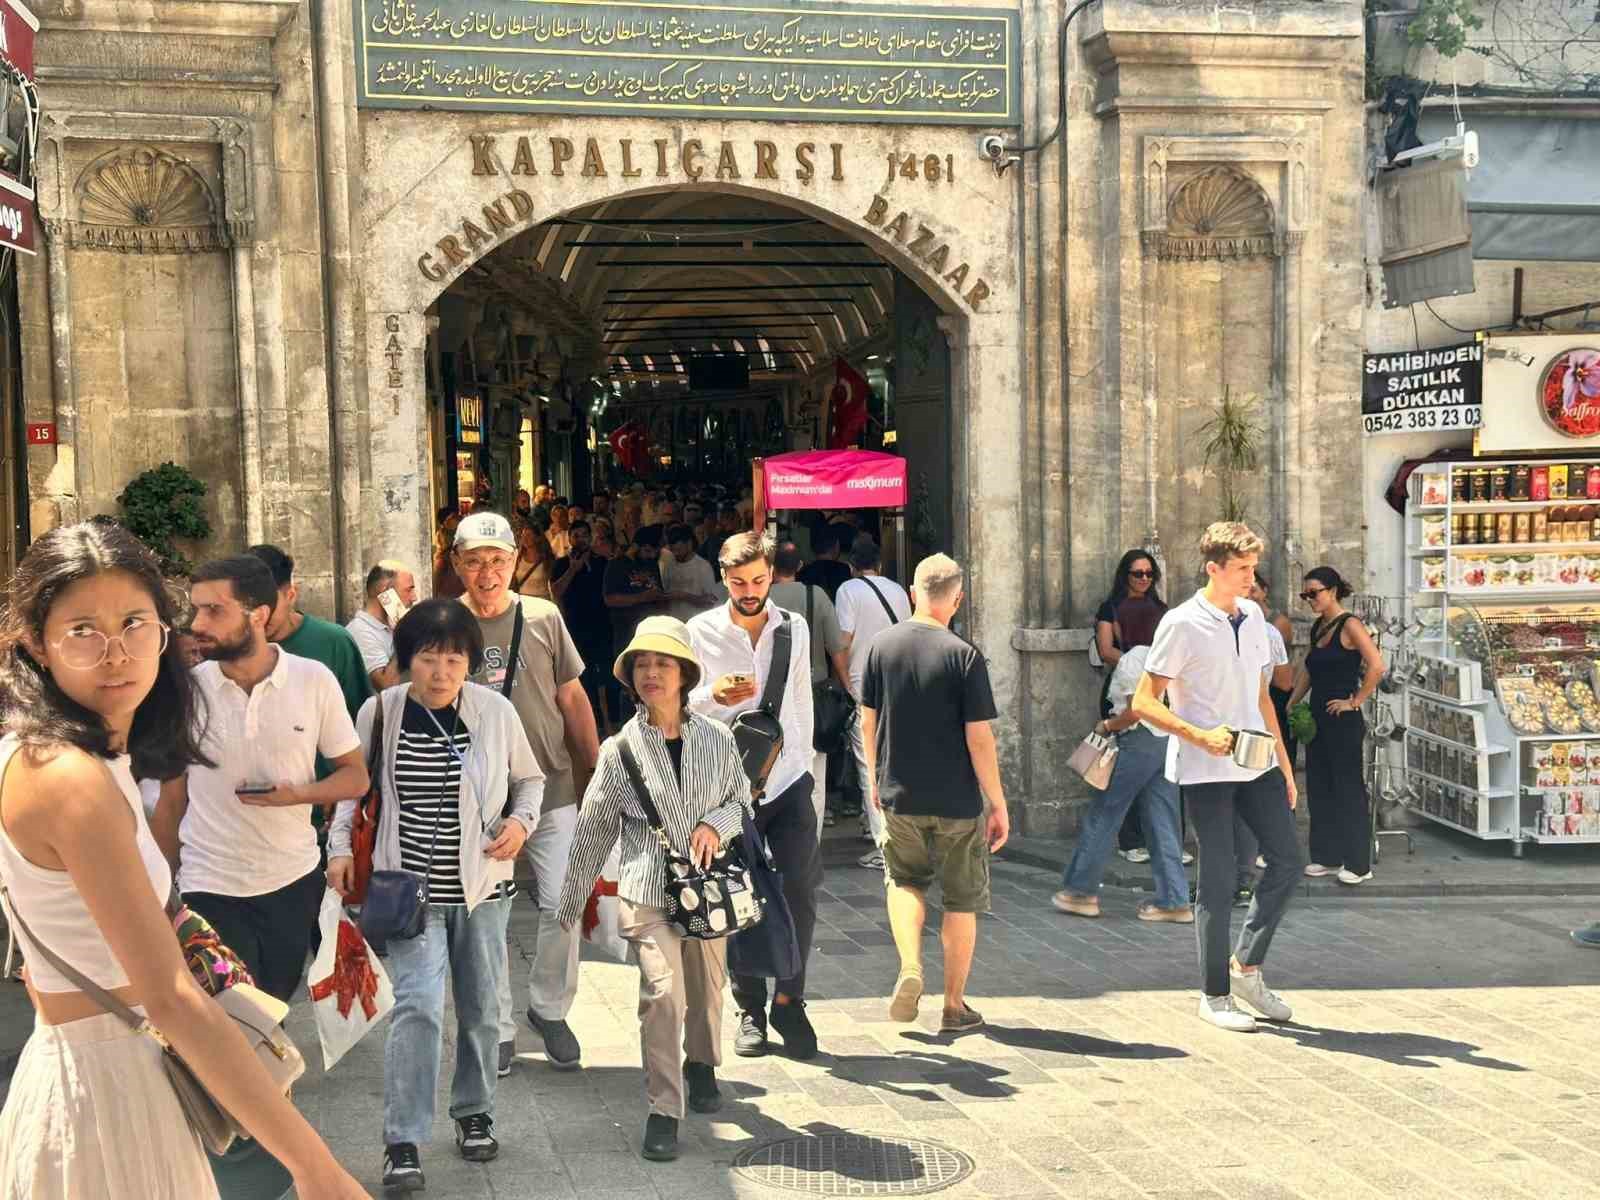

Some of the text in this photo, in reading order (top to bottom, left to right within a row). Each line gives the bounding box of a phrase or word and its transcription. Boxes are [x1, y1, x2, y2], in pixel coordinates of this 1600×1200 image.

[887, 152, 954, 183] 1461
[417, 188, 992, 313] GRAND BAZAAR
[385, 314, 403, 388] GATE
[1366, 346, 1481, 374] SAHİBİNDEN
[1387, 368, 1462, 393] SATILIK
[1382, 388, 1465, 412] DÜKKAN
[1364, 407, 1482, 433] 0542 383 23 03
[35, 428, 49, 440] 15
